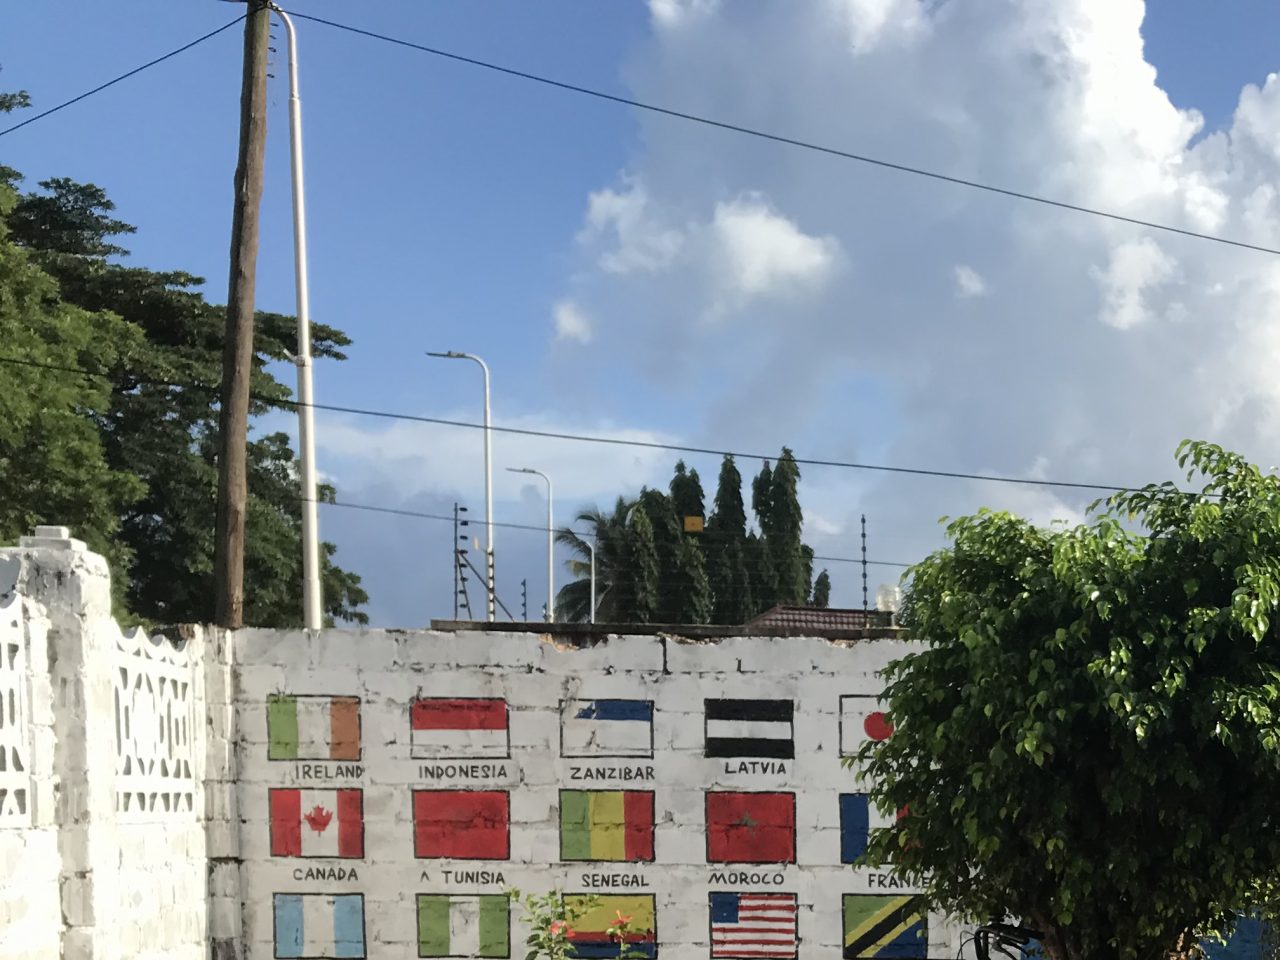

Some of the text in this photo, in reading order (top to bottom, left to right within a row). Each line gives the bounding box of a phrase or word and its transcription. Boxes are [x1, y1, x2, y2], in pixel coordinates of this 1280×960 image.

[294, 765, 365, 780] IRELAND
[418, 764, 508, 779] INDONESIA
[569, 765, 656, 781] ZANZIBAR
[724, 761, 787, 776] LATVIA
[293, 867, 359, 882] CANADA
[441, 870, 505, 885] TUNISIA
[581, 873, 650, 888] SENEGAL
[707, 872, 785, 887] MOROCO
